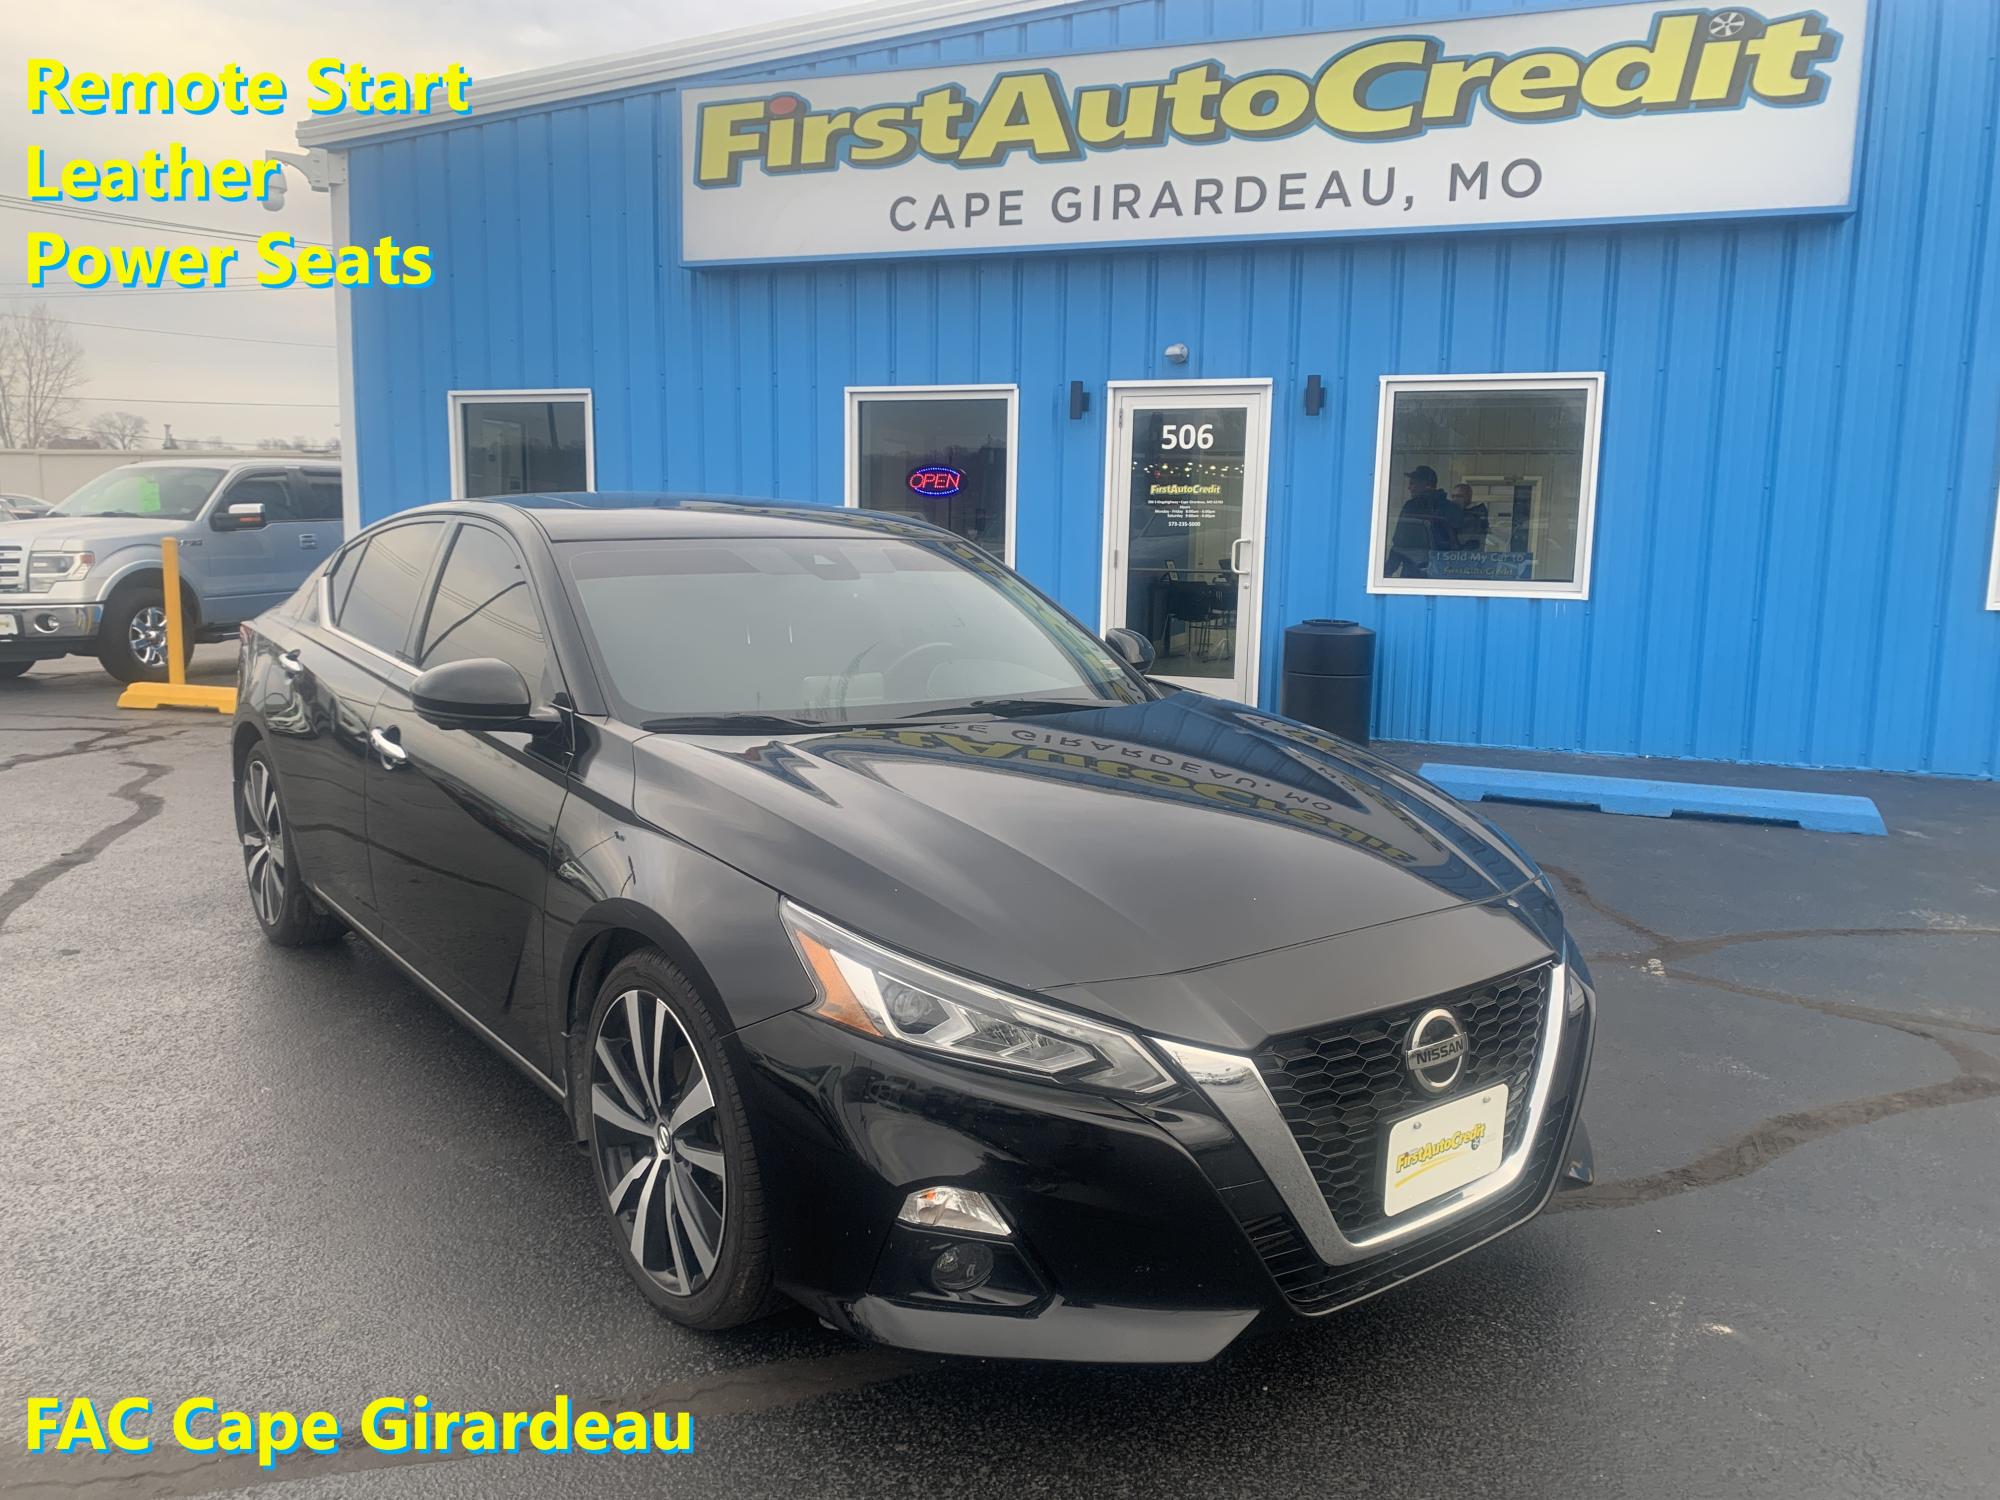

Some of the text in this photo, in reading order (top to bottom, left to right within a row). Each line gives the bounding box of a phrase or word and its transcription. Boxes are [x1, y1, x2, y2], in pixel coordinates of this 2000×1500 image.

[694, 7, 1842, 189] FirstAutoCredit
[889, 158, 1543, 232] CAPE GIRARDEAU, MO
[1161, 424, 1214, 449] 506
[910, 473, 960, 488] OPEN
[1150, 484, 1221, 495] FirstAutoCredit
[1471, 552, 1487, 564] My
[1416, 1040, 1464, 1064] NISSAN
[1395, 1121, 1486, 1173] FirstAutoCredit
